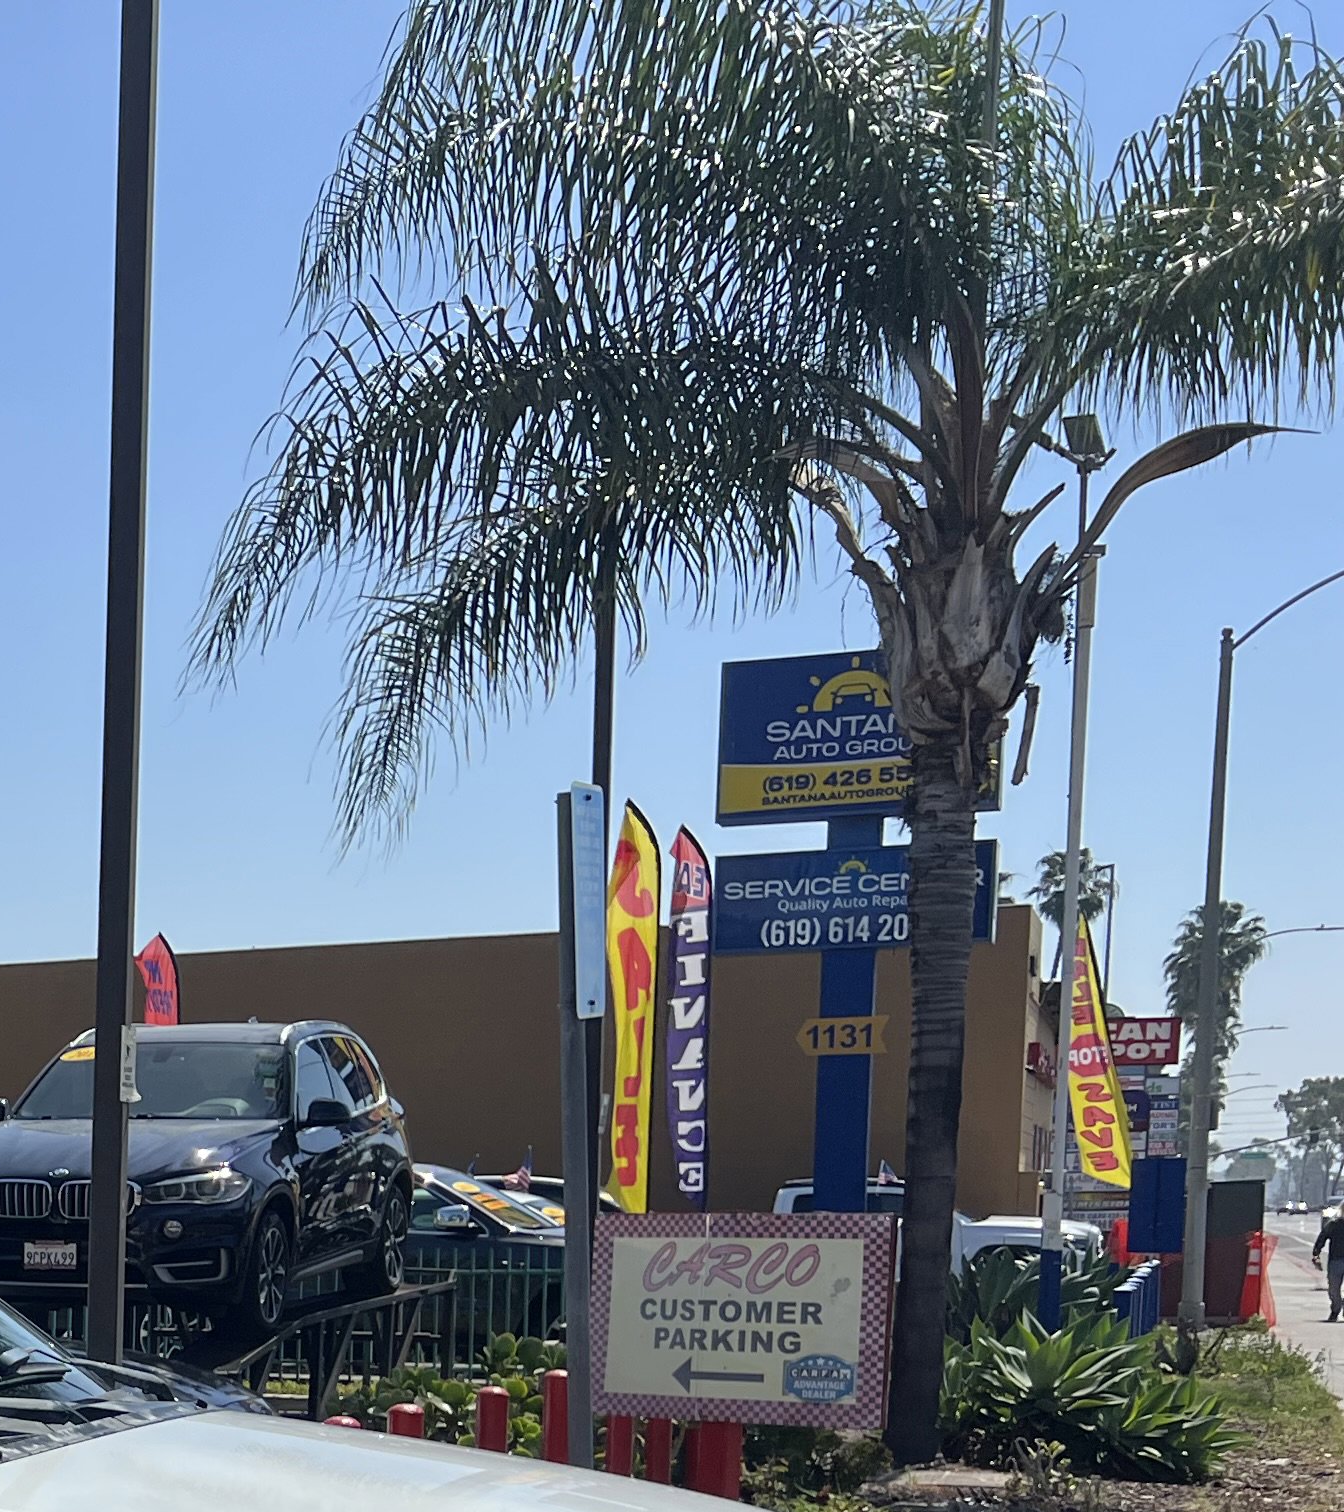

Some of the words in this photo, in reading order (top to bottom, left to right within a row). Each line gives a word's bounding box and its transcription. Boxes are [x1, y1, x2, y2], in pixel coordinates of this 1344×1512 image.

[773, 741, 840, 761] AUTO
[845, 737, 913, 755] GROU
[763, 772, 817, 794] (619)
[823, 768, 872, 786] 426
[879, 765, 912, 783] 55
[724, 876, 851, 900] SERVICE
[778, 899, 830, 913] Quality
[833, 896, 868, 909] Auto
[872, 894, 907, 909] Repa
[761, 917, 822, 947] (619)
[828, 915, 870, 944] 614
[877, 913, 909, 942] 20
[805, 1022, 873, 1050] 1131
[26, 1250, 75, 1266] 9CPK499
[642, 1241, 821, 1294] CARCO
[639, 1298, 823, 1325] CUSTOMER
[653, 1327, 802, 1353] PARKING
[793, 1380, 846, 1390] ADVANTAGE
[801, 1389, 837, 1399] DEALER
